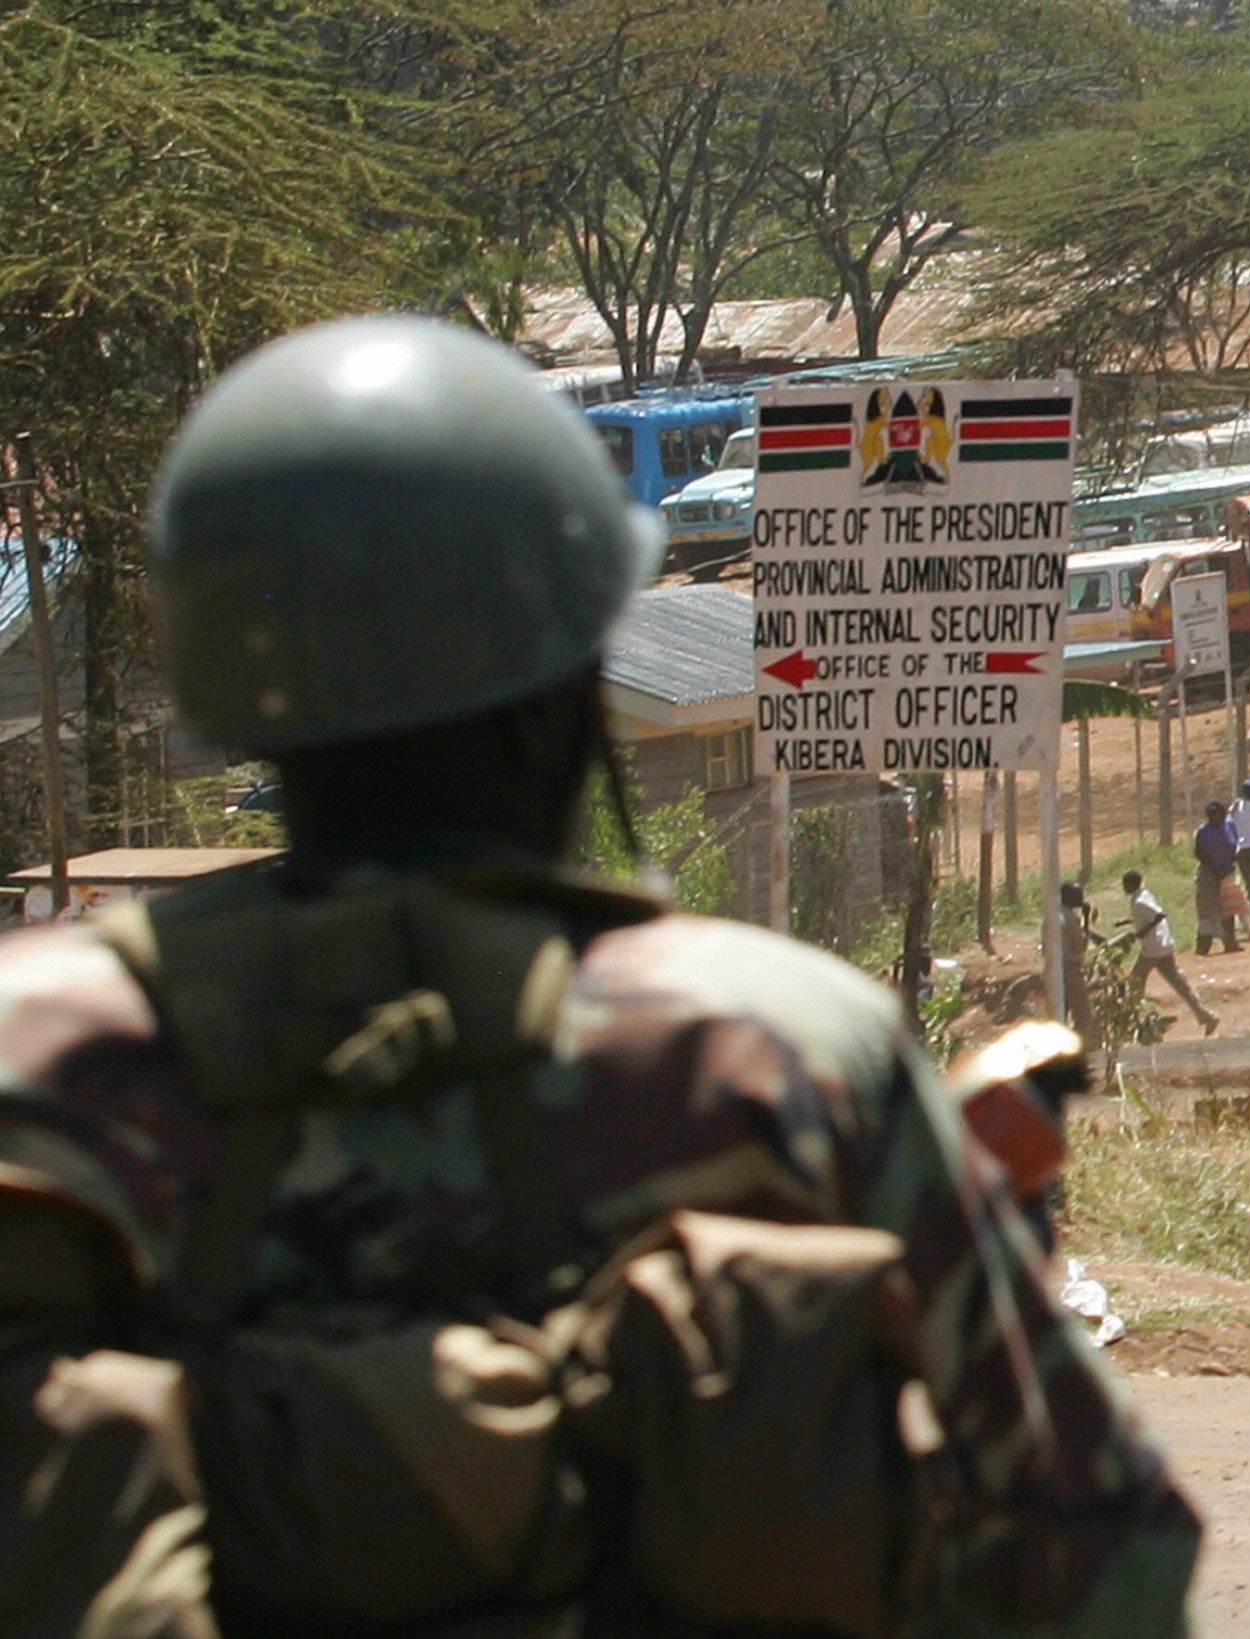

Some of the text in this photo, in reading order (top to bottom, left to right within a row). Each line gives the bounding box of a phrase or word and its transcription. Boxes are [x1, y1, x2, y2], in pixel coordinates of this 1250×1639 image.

[754, 501, 1068, 547] OFFICE OF THE PRESIDENT
[753, 558, 871, 598] PROVINCIAL
[754, 602, 1060, 650] AND INTERNAL SECURITY
[816, 651, 985, 680] OFFICE OF THE
[759, 684, 1018, 731] DISTRICT OFFICER
[775, 736, 999, 771] KIBERA DIVISION.
